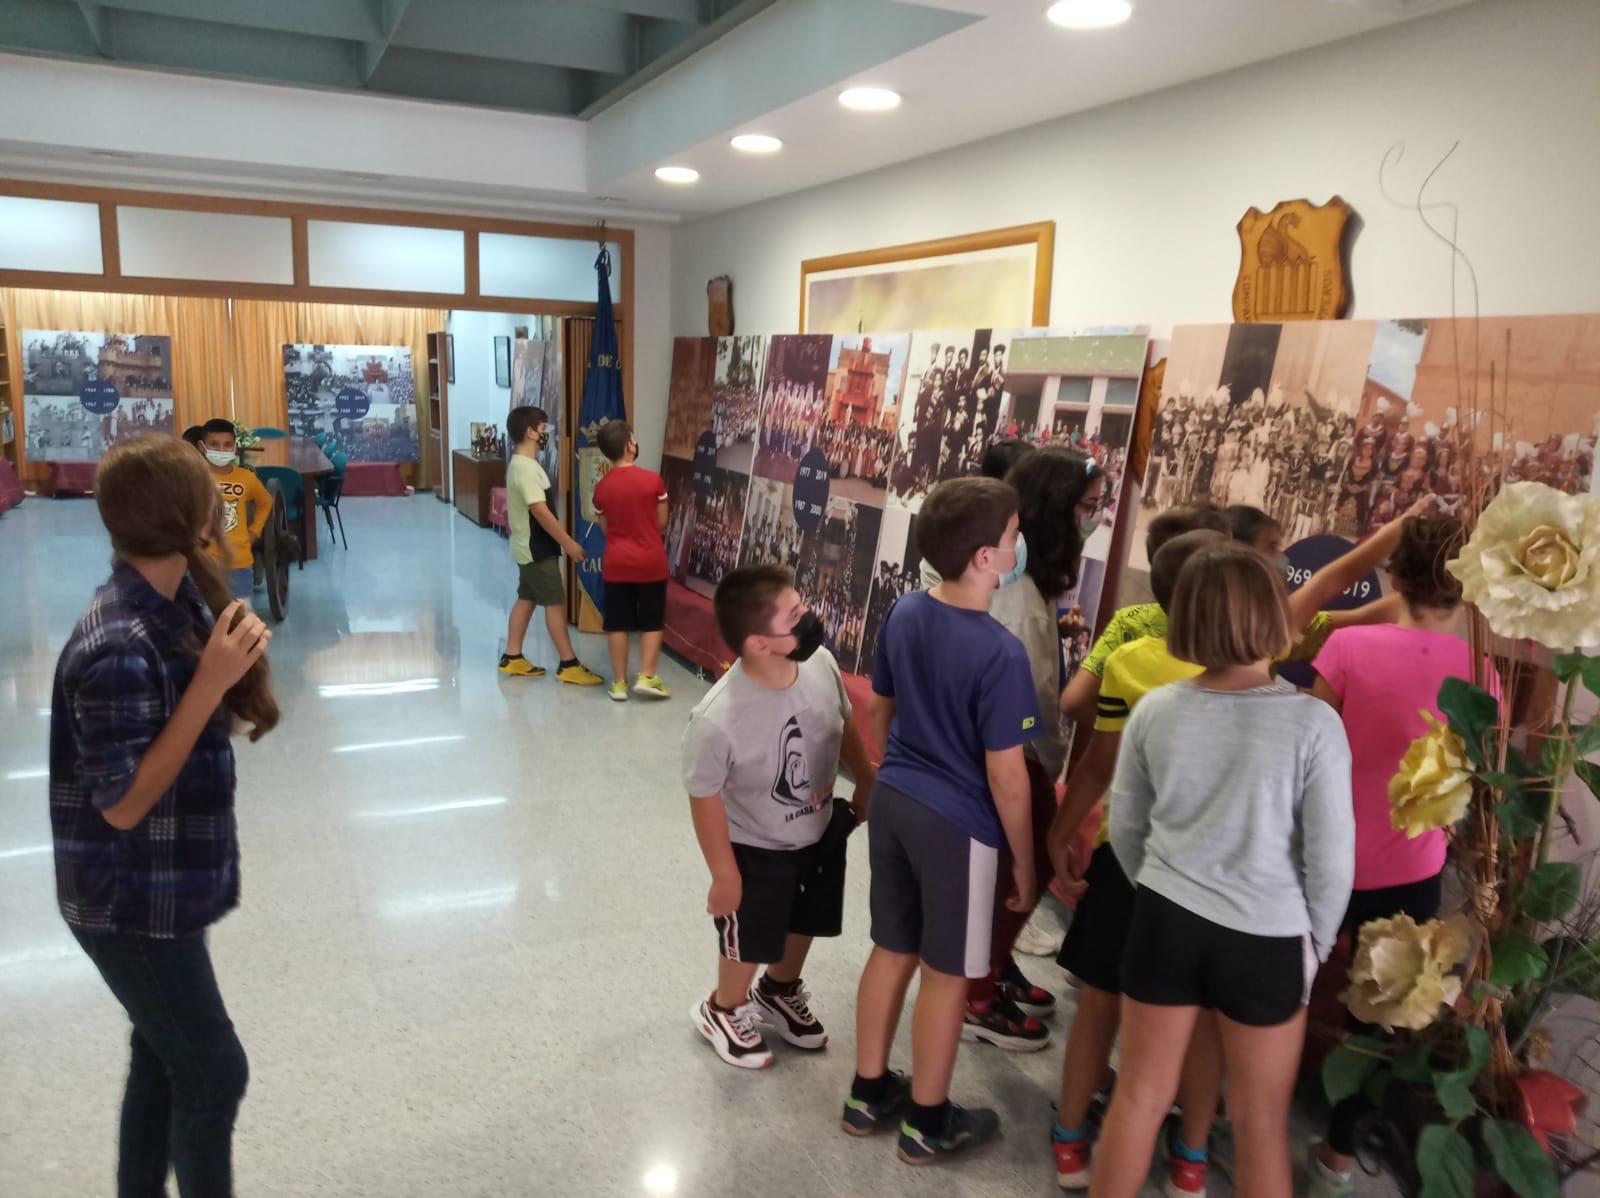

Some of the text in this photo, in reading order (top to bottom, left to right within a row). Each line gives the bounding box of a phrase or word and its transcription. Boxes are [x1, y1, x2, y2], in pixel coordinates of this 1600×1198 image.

[799, 466, 812, 477] 1977
[1287, 565, 1371, 598] 969 19
